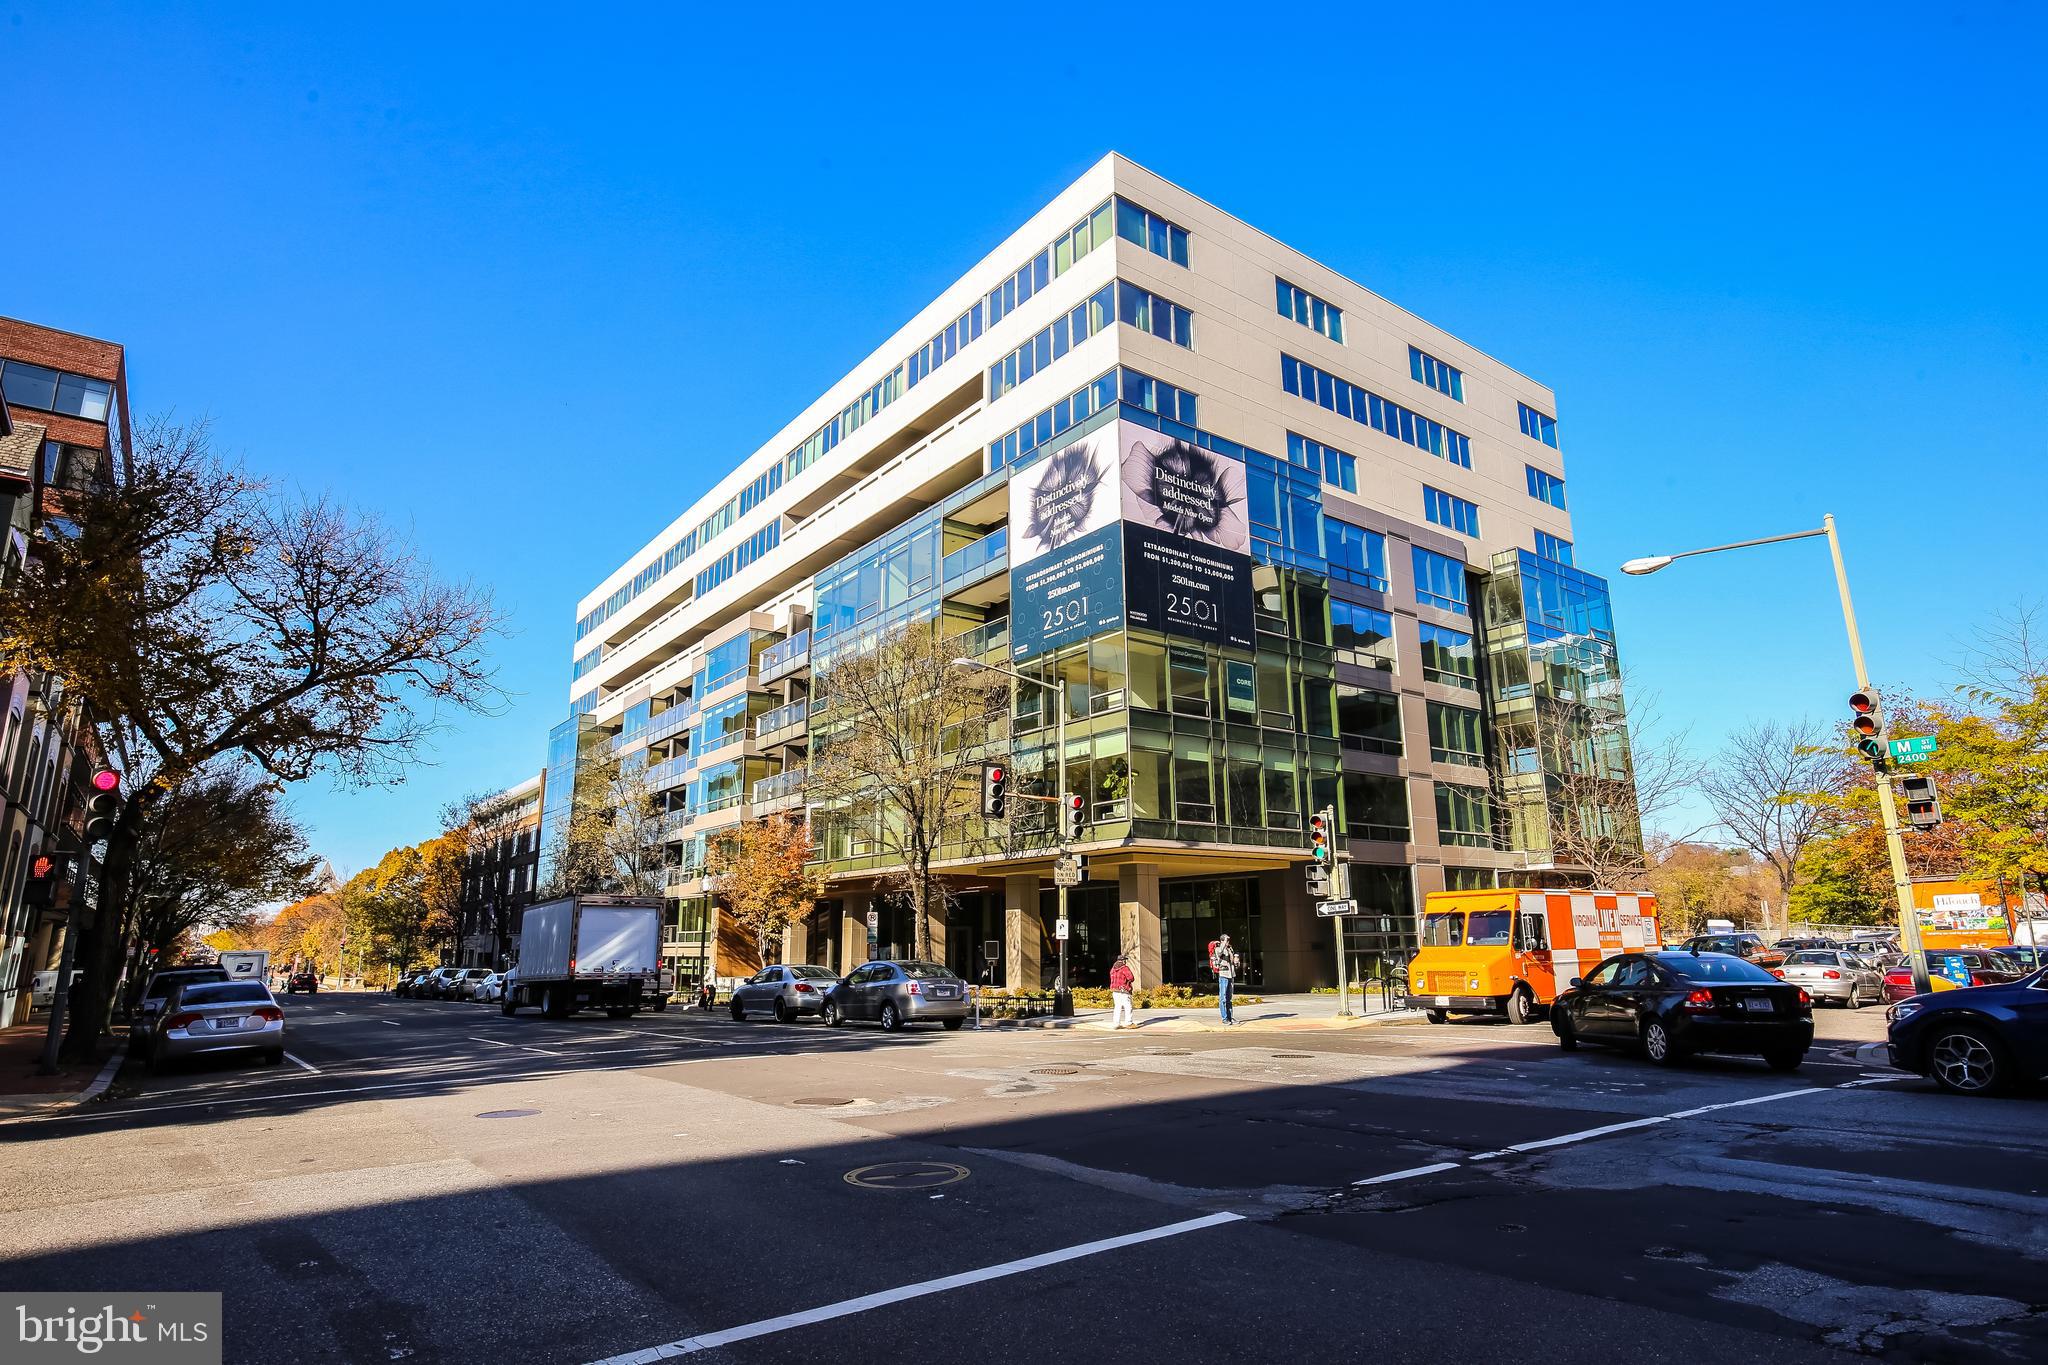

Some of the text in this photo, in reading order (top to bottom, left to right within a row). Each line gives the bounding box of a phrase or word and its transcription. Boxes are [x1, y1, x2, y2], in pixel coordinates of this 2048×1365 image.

[1036, 473, 1088, 509] Distinctively
[1155, 467, 1216, 500] Distinctively
[1162, 486, 1213, 511] addressed.
[1163, 501, 1213, 523] Models Now Open
[1143, 541, 1234, 571] EXTRAORDINARY CONDOMINIUMS
[1143, 552, 1160, 561] FROM
[1025, 583, 1039, 592] FROM
[1171, 574, 1210, 591] 2501m.com
[1043, 596, 1088, 630] 2501
[1167, 593, 1217, 622] 2501
[1236, 678, 1252, 686] CORE
[1896, 741, 1912, 753] M
[1898, 752, 1927, 763] 2400
[1574, 908, 1643, 933] VIRGINIA LINEN SERVICE
